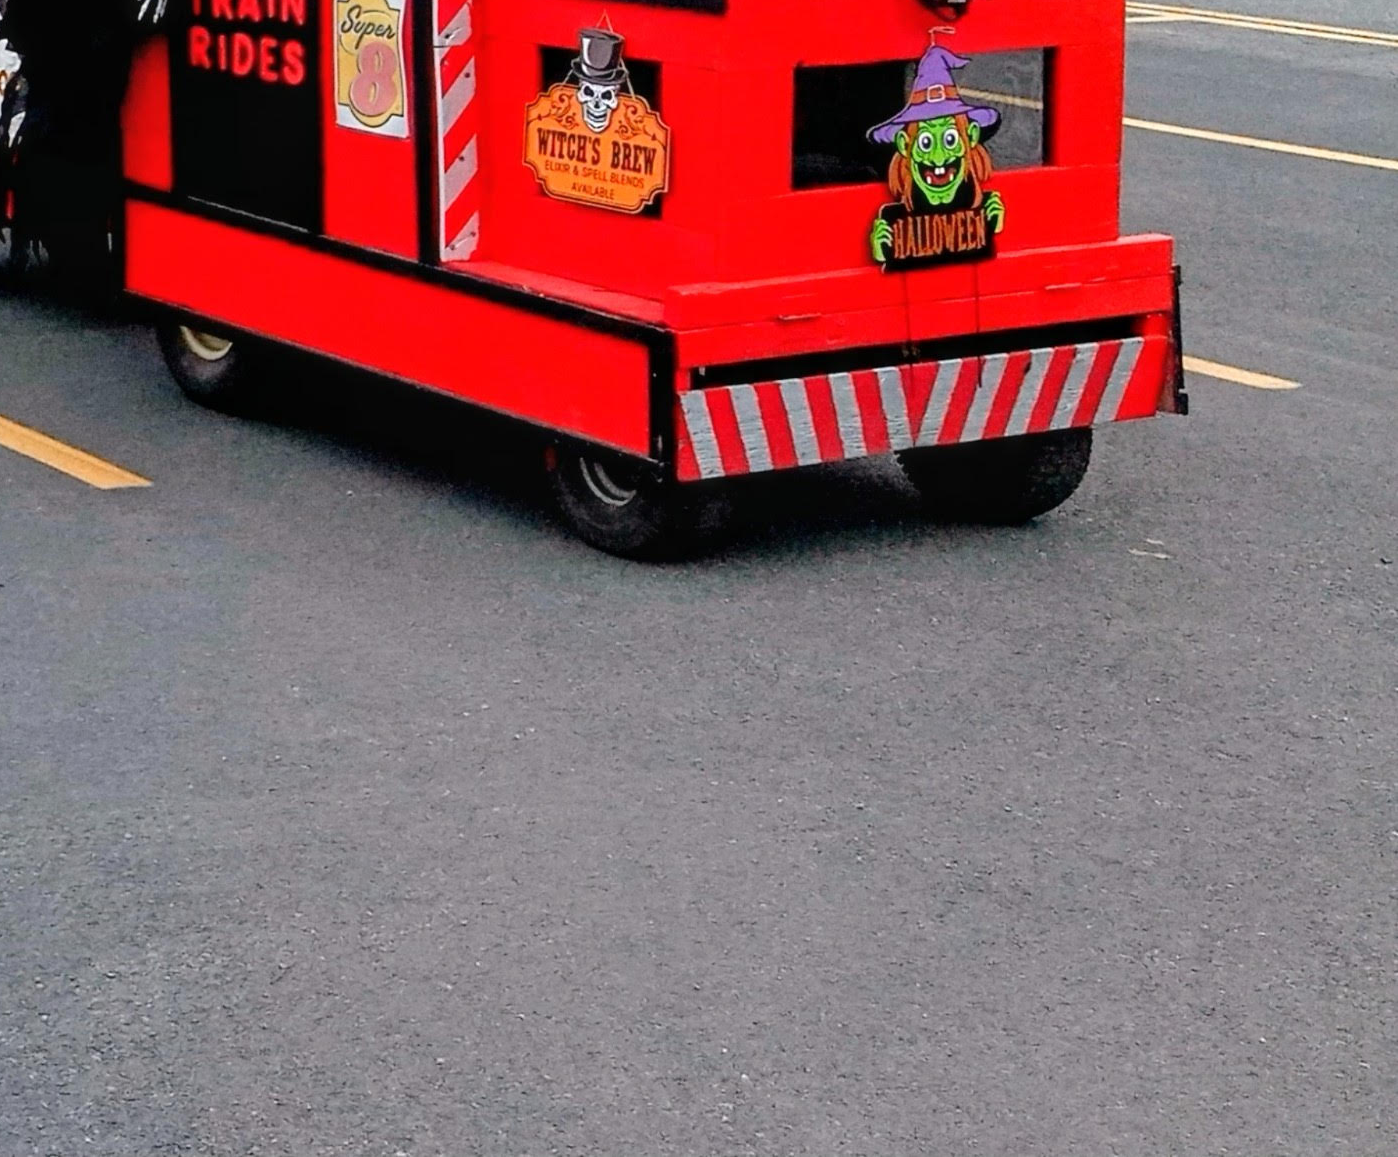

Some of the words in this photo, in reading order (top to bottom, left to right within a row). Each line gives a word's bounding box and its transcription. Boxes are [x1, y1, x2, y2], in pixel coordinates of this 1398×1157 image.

[340, 4, 396, 51] Super
[188, 25, 306, 86] RIDES
[348, 41, 399, 118] 8
[536, 127, 602, 166] WITCH'S
[610, 139, 658, 176] BREW
[544, 159, 571, 174] ELIXIR
[572, 164, 580, 177] &
[582, 166, 609, 182] SPELL
[609, 171, 646, 189] BLENDS
[571, 181, 615, 201] AVAILABLE
[892, 207, 988, 260] HALLOWEEN
